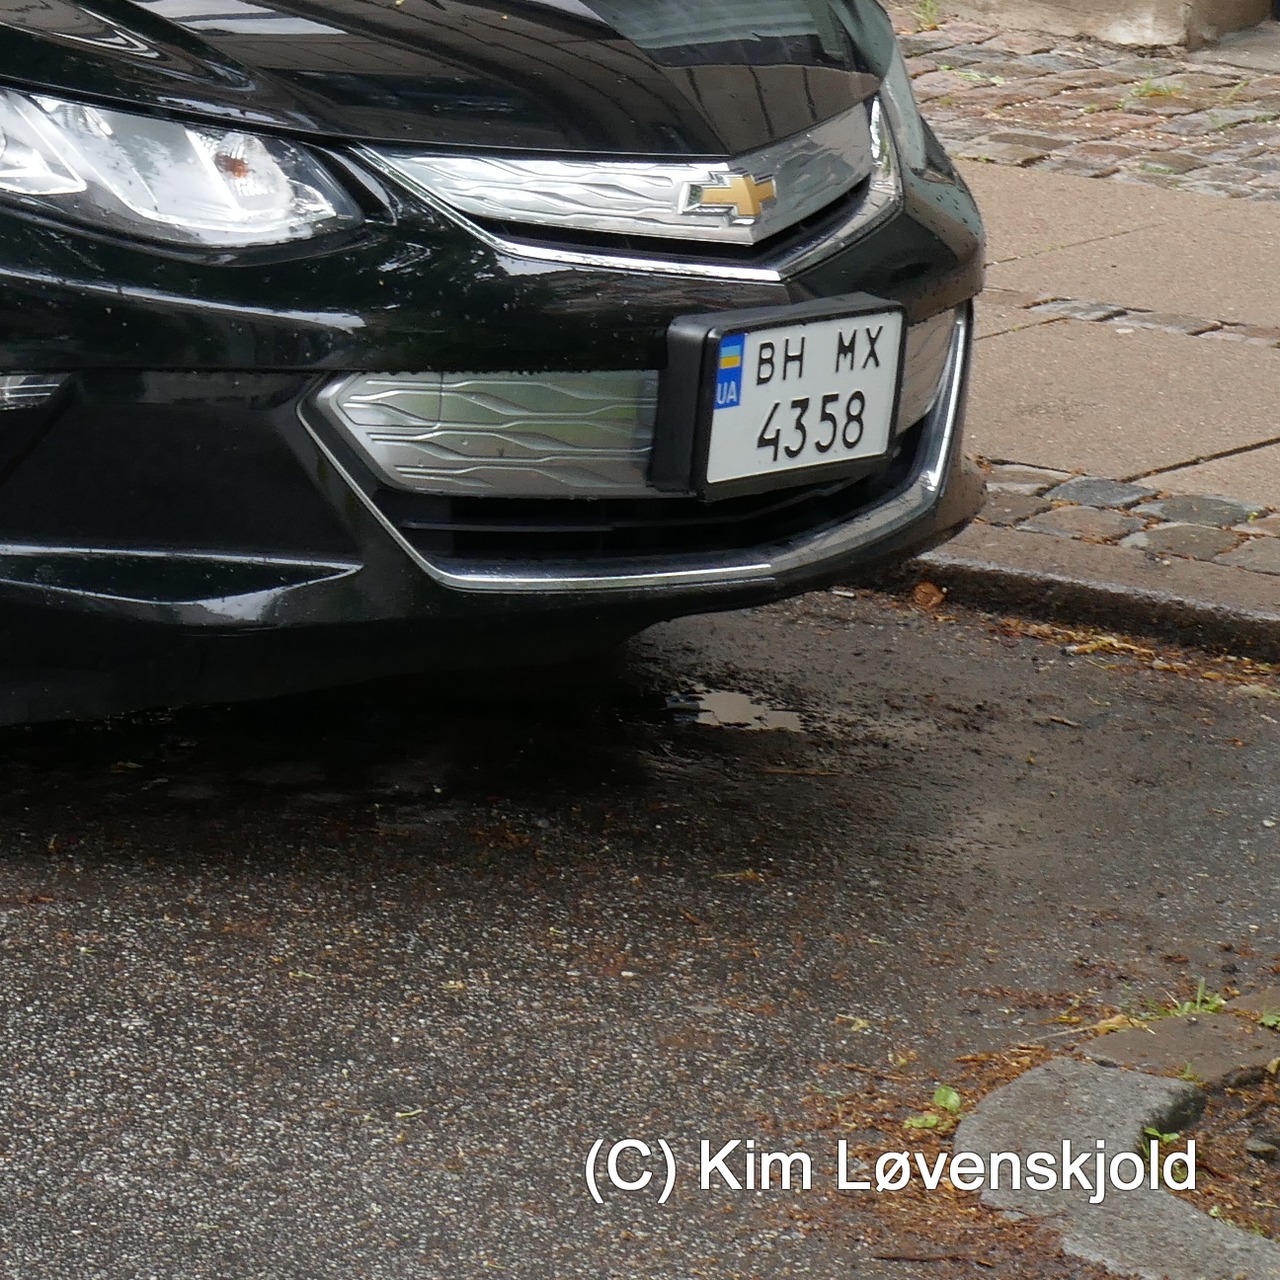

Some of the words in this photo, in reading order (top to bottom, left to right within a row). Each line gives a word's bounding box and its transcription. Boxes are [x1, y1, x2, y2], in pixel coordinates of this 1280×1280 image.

[756, 336, 806, 385] BH
[835, 325, 884, 372] MX
[717, 380, 738, 404] UA
[756, 390, 867, 462] 4358
